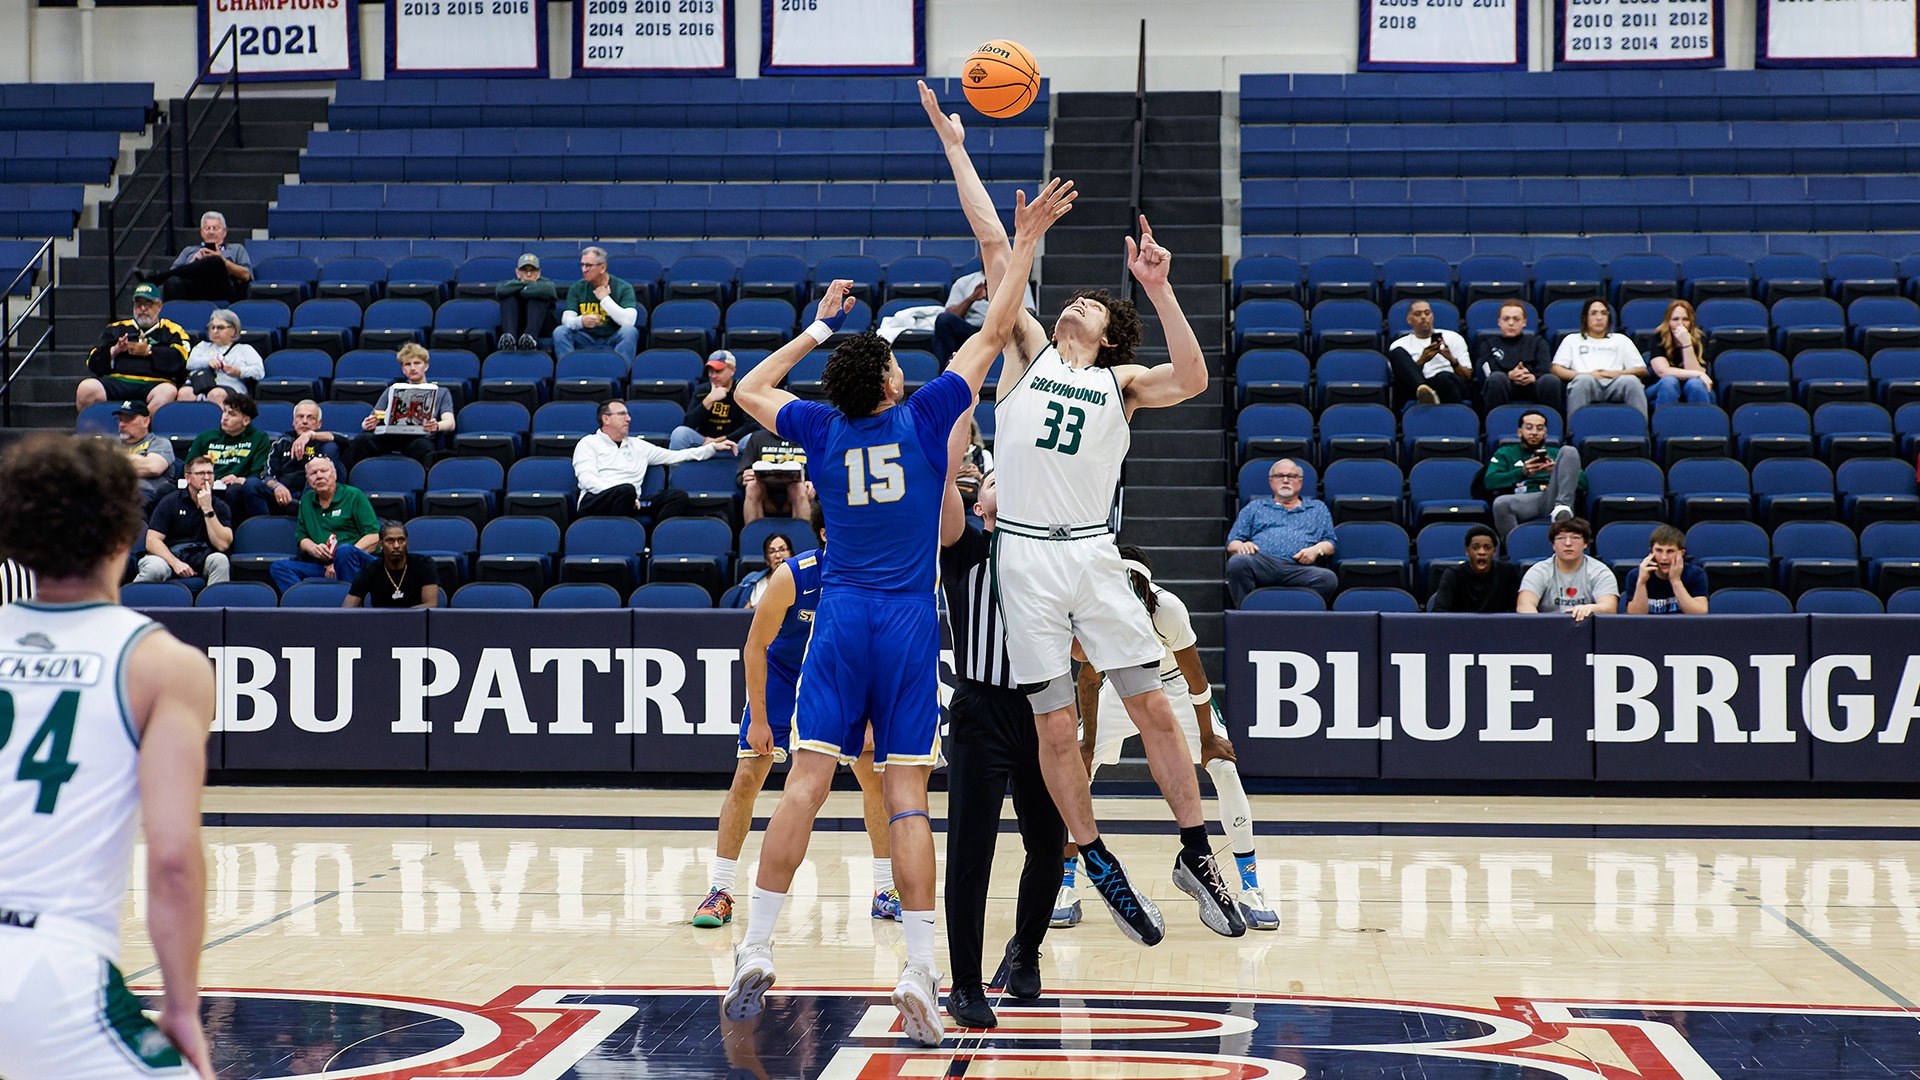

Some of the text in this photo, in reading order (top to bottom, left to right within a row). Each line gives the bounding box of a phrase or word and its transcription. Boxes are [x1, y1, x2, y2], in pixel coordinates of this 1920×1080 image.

[216, 0, 339, 12] CHAMPIONS
[404, 1, 529, 16] 2013 2015 2016
[589, 0, 714, 14] 2009 2010 2013
[781, 0, 817, 11] 2016
[1379, 16, 1416, 29] 2018
[1573, 12, 1708, 28] 2010 2011 2012
[589, 23, 714, 36] 2014 2015 2016
[240, 25, 317, 55] 2021
[1572, 36, 1708, 50] 2013 2014 2015
[588, 46, 624, 59] 2017
[1030, 376, 1109, 407] GREYHOUNDS
[1035, 400, 1086, 456] 33
[844, 443, 906, 506] 15
[208, 646, 362, 733] BU
[1247, 650, 1920, 745] BLUE BRIGA
[0, 688, 82, 816] 4
